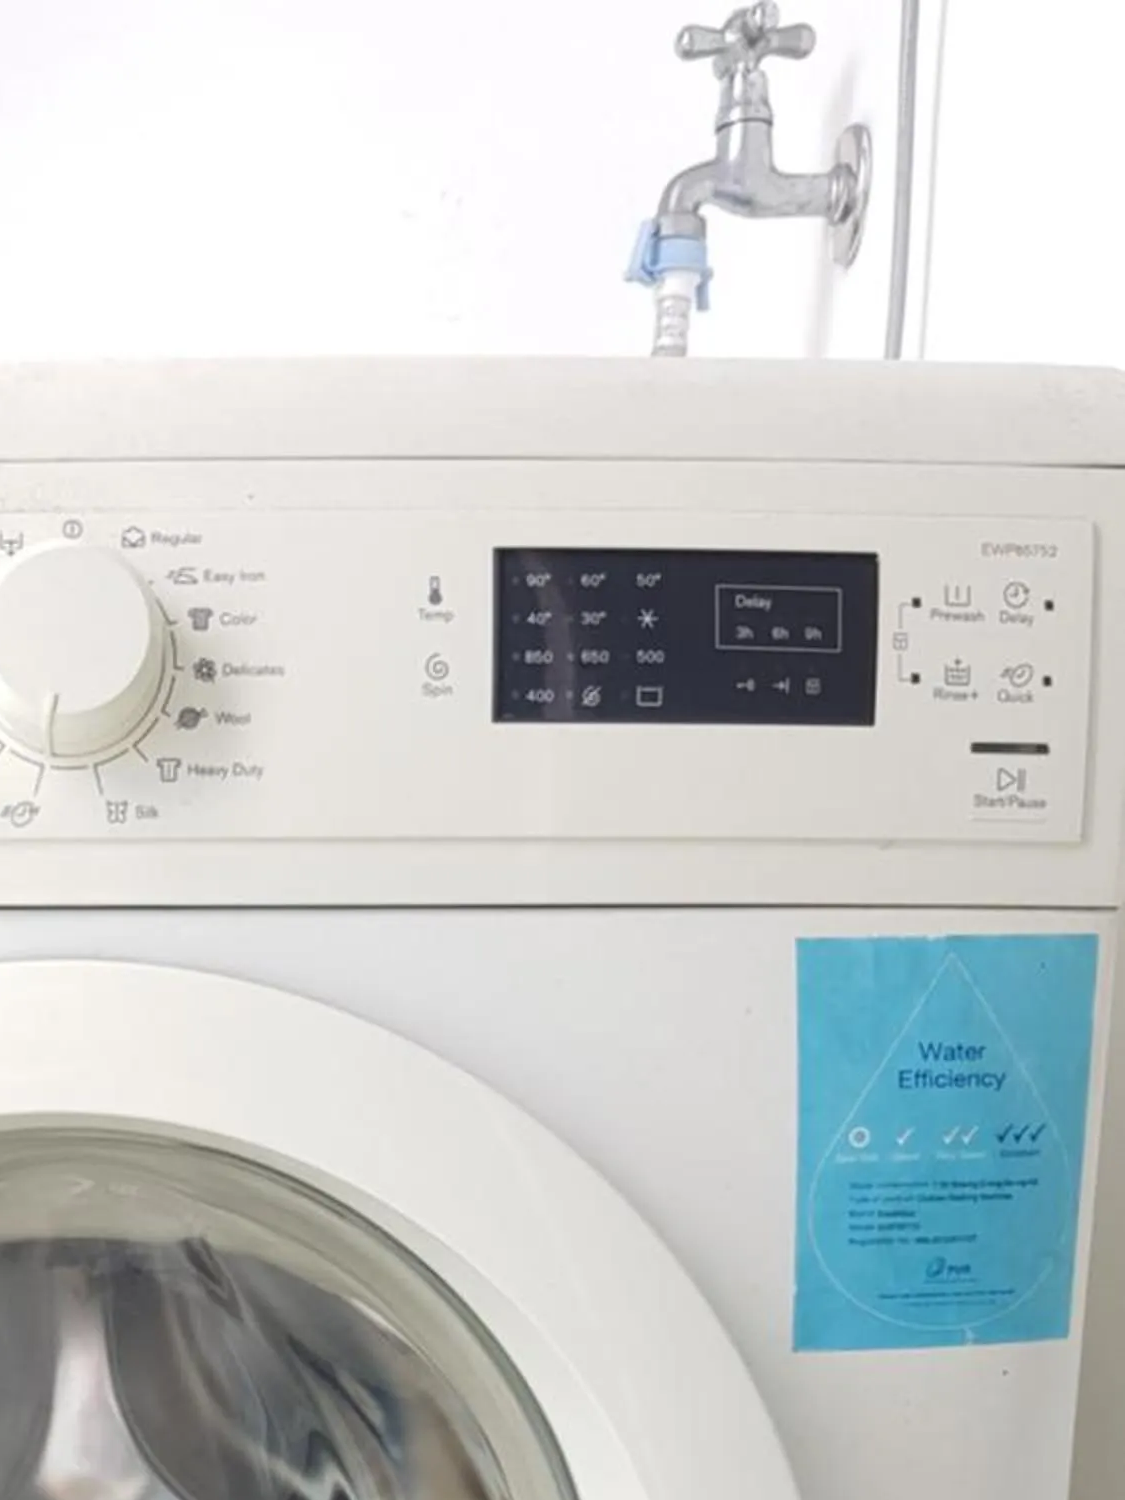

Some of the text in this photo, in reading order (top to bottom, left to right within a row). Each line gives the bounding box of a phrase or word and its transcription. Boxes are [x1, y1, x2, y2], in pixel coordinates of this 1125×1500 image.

[150, 532, 201, 547] Regular
[203, 569, 265, 584] Easy Iron
[735, 593, 772, 612] Delay
[219, 612, 258, 626] Color
[418, 609, 453, 625] Temp
[930, 608, 985, 622] Prewash
[999, 609, 1034, 627] Delay
[736, 625, 754, 640] 3h
[636, 649, 665, 664] 500
[222, 663, 285, 677] Delicates
[421, 683, 452, 699] Spin
[526, 688, 555, 703] 400
[997, 689, 1034, 704] Quick
[215, 711, 251, 725] Wool
[187, 763, 264, 778] Heavy Duty
[973, 793, 1047, 809] Start/Pause
[135, 805, 159, 820] Silk
[919, 1041, 987, 1063] Water
[898, 1067, 1007, 1092] Efficiency
